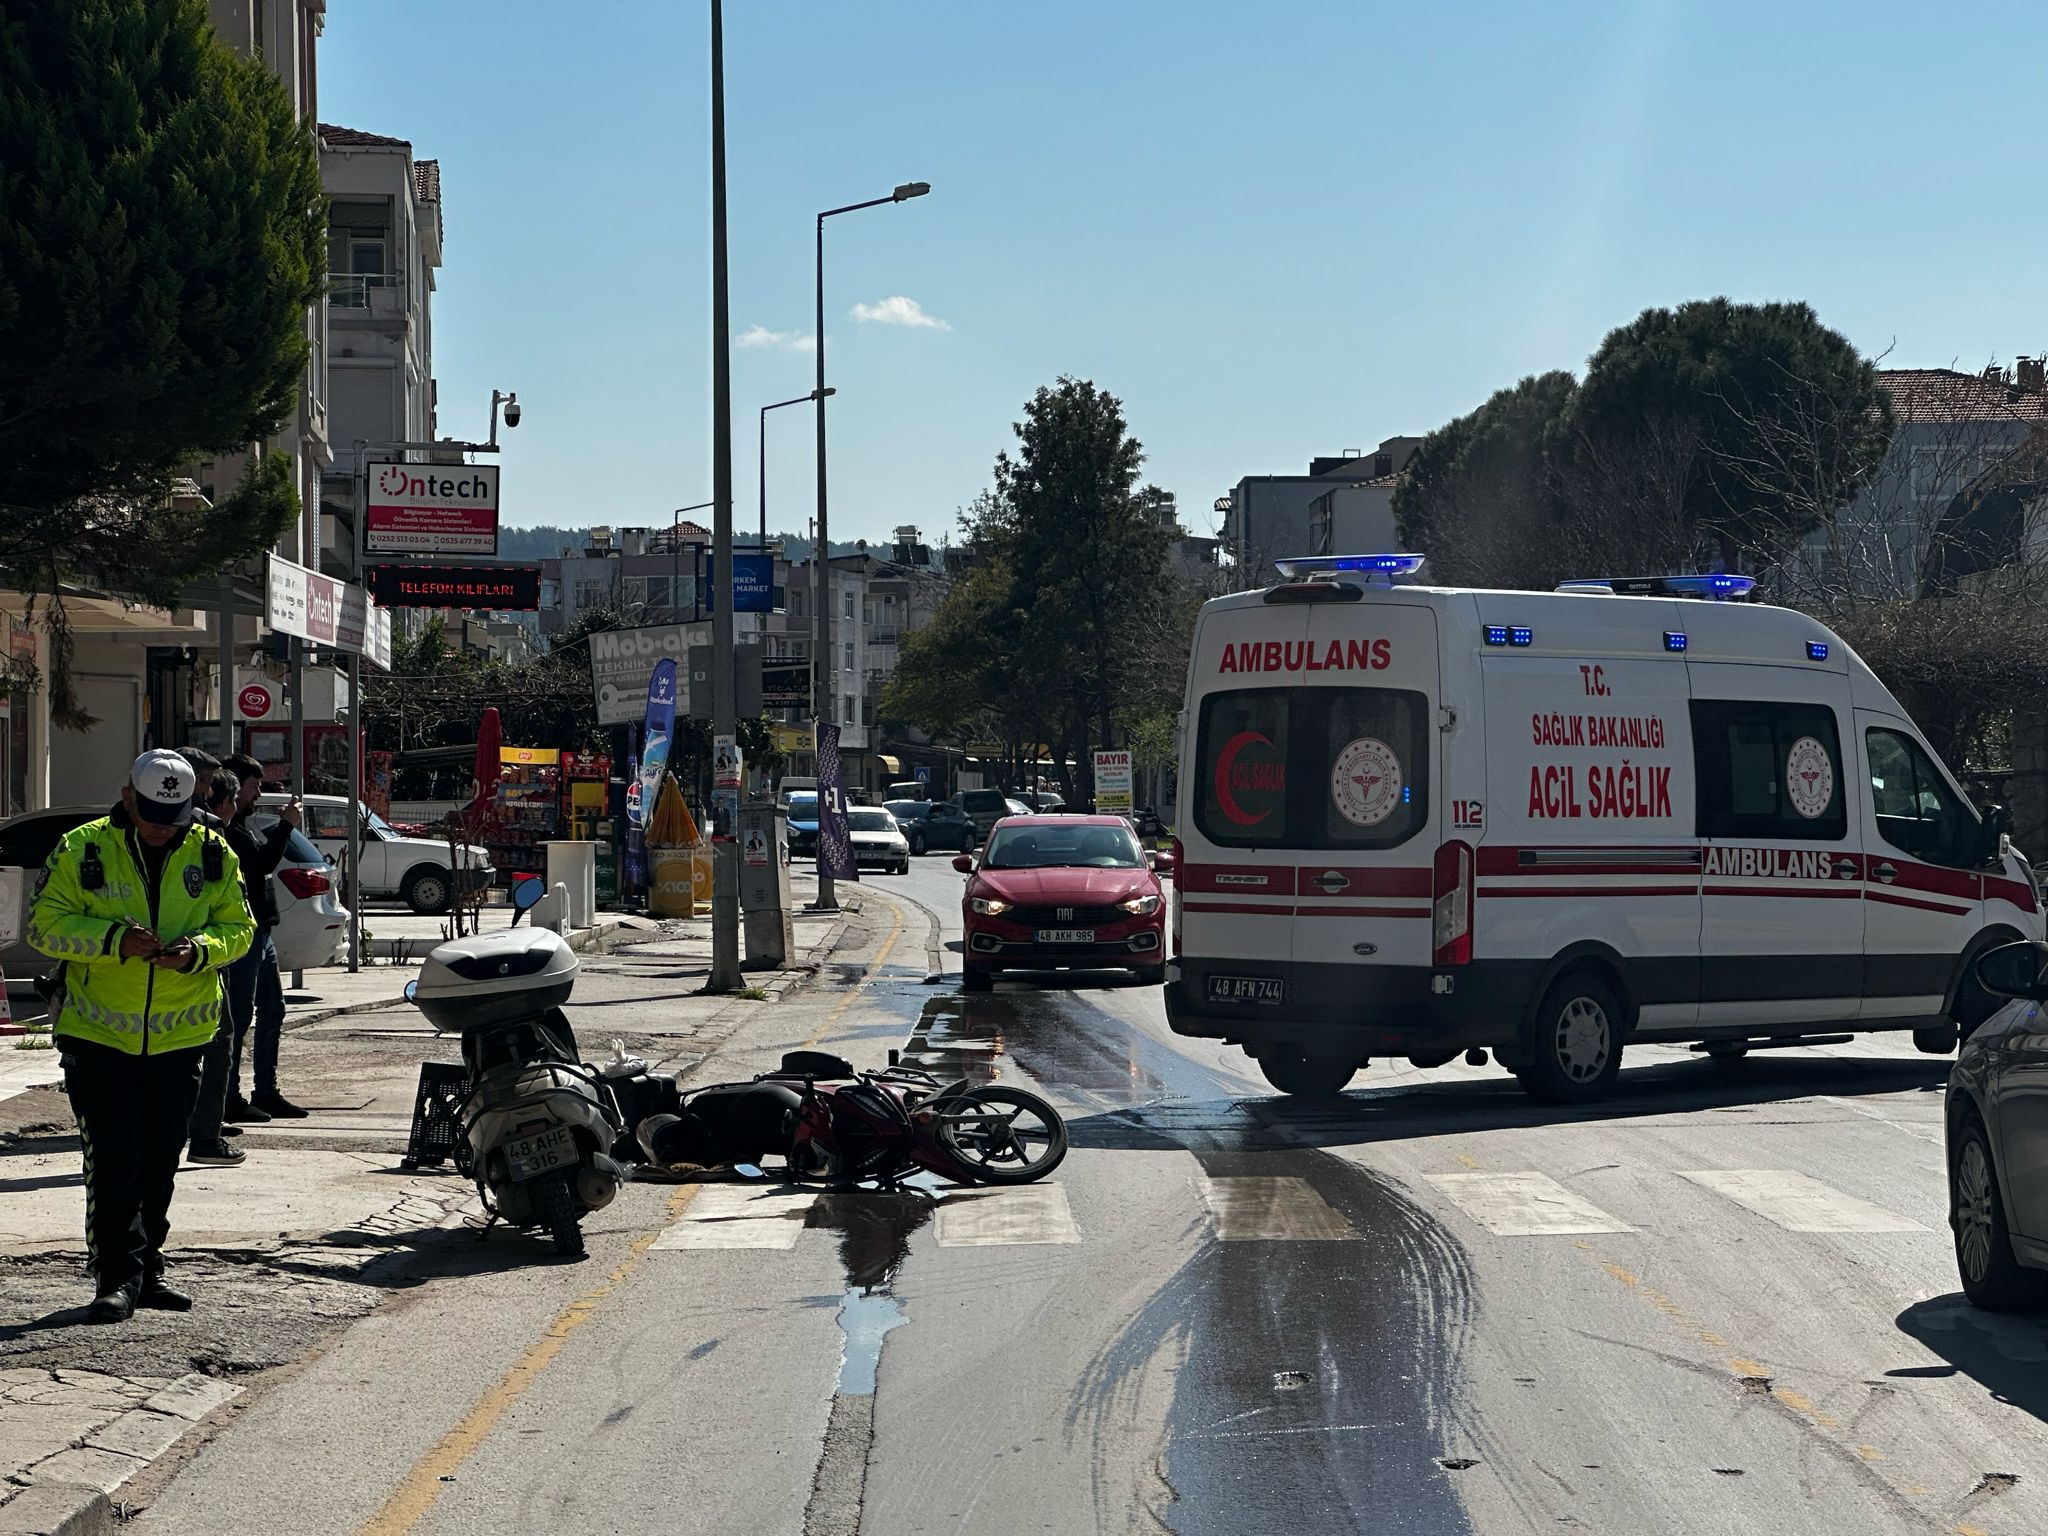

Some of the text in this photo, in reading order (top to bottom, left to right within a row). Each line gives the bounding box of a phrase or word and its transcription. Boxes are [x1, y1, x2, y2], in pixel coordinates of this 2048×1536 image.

[399, 582, 454, 593] TELEFON
[597, 659, 647, 673] TEKNİK
[1219, 639, 1391, 674] AMBULANS
[1579, 664, 1612, 697] T.C.
[1532, 711, 1665, 749] SAĞLIK BAKANLIĞI
[1096, 753, 1128, 765] BAYIR
[1587, 759, 1672, 818] SAĞLIK
[1453, 800, 1482, 823] 112
[1704, 847, 1832, 879] AMBULANS
[1056, 907, 1073, 921] FIAT
[1040, 931, 1051, 941] 48
[1055, 931, 1072, 941] AKH
[1076, 931, 1093, 941] 985
[1215, 978, 1280, 999] 48 AFN 744
[510, 1128, 569, 1158] 48 AHE
[529, 1151, 558, 1171] 316
